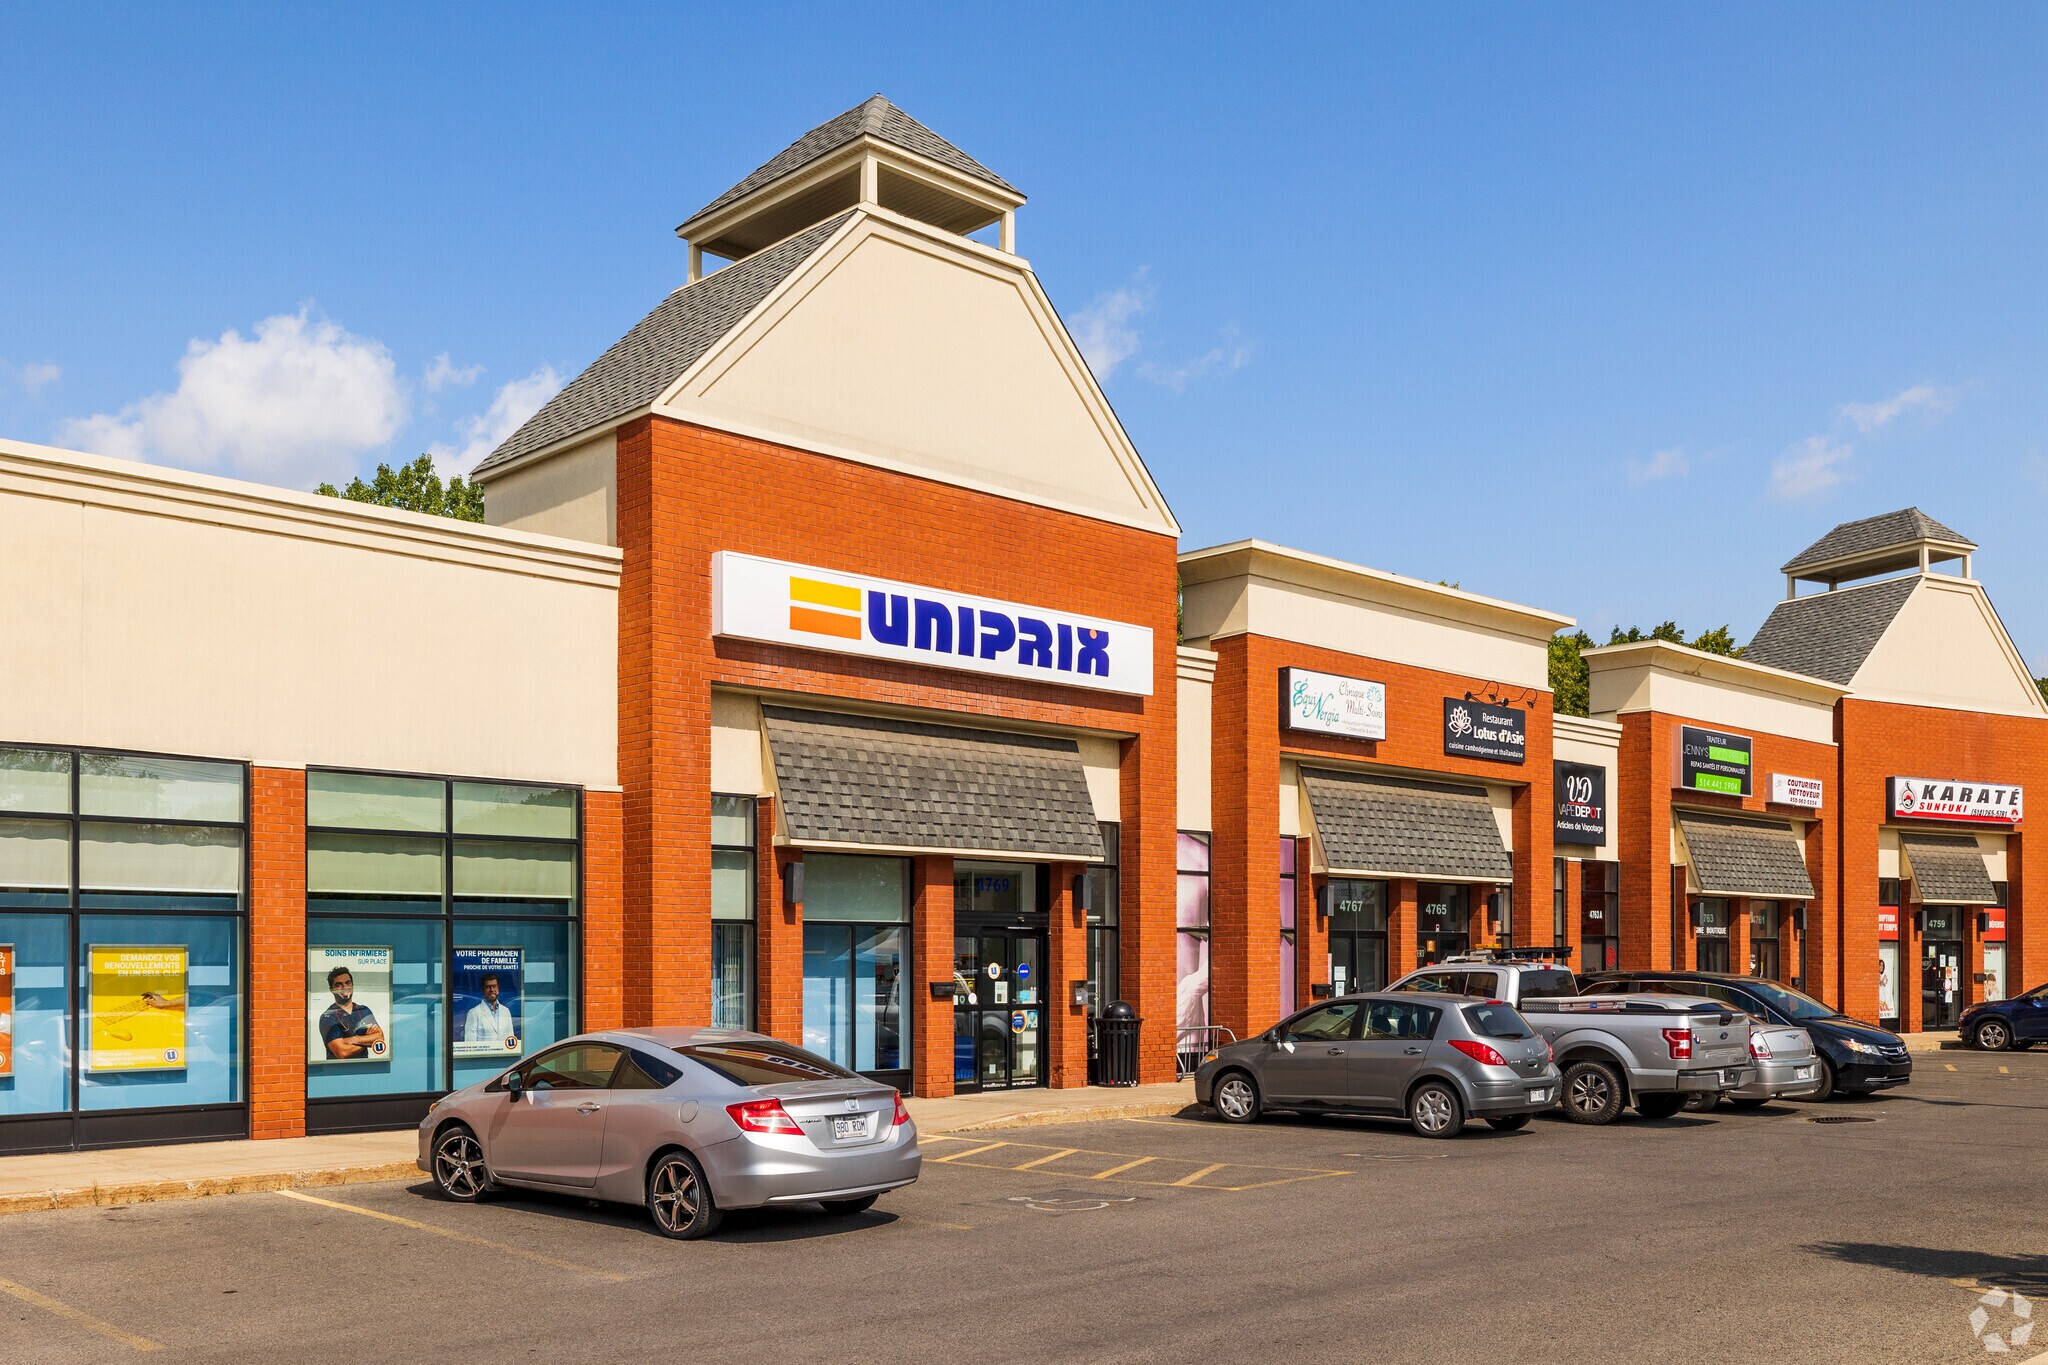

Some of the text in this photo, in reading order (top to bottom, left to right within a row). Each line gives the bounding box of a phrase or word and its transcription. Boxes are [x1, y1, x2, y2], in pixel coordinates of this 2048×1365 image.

[868, 590, 1109, 677] UNIPRIX
[1339, 680, 1365, 699] Clinique
[1482, 712, 1513, 726] Restaurant
[1473, 725, 1524, 745] Lotus d'Asie
[1706, 735, 1727, 745] TRAITEUR
[1448, 742, 1464, 750] cuisine
[1465, 744, 1494, 755] cambodgienne
[1922, 784, 2020, 806] KARATÉ
[1920, 801, 1967, 813] SUNFUKI
[1557, 820, 1604, 834] Articles de Vapotage
[977, 877, 1009, 892] 4769
[1340, 900, 1363, 911] 4767
[1426, 904, 1447, 914] 4765
[1703, 914, 1714, 923] 763
[1928, 919, 1946, 928] 4759
[120, 953, 180, 962] DEMANDEZ VOS
[325, 949, 387, 957] SOINS INFIRMIERS
[456, 949, 519, 957] VOTRE PHARMACIEN
[104, 961, 180, 970] RENOUVELLEMENTS
[118, 969, 129, 977] EN
[142, 969, 161, 977] SEUL
[163, 969, 180, 977] CLIC
